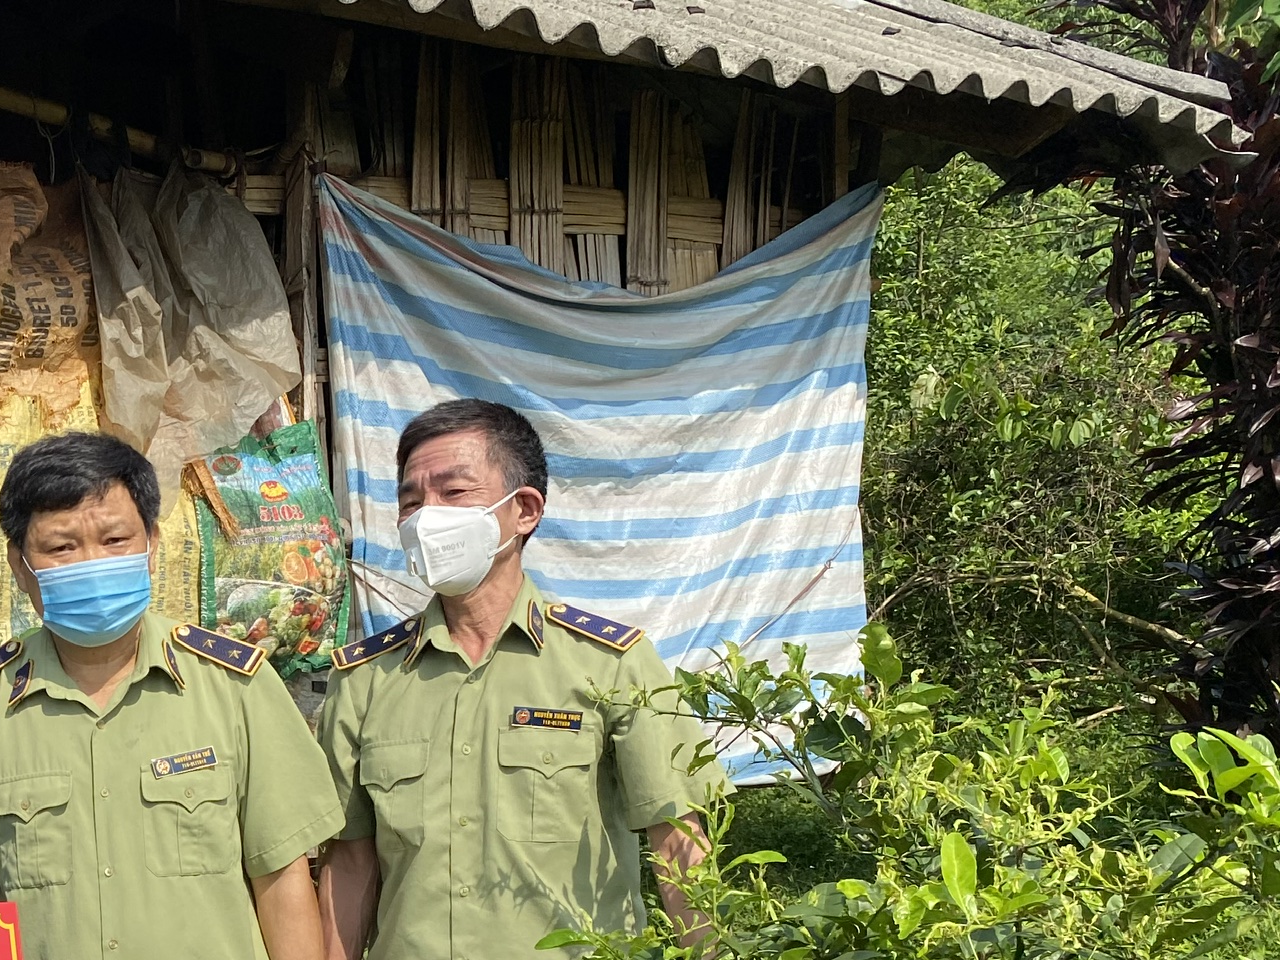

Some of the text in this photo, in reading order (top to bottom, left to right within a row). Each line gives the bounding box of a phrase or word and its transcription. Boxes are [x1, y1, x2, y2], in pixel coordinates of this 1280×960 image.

[51, 276, 74, 299] KG
[24, 297, 52, 359] BIURET
[60, 304, 78, 328] 50
